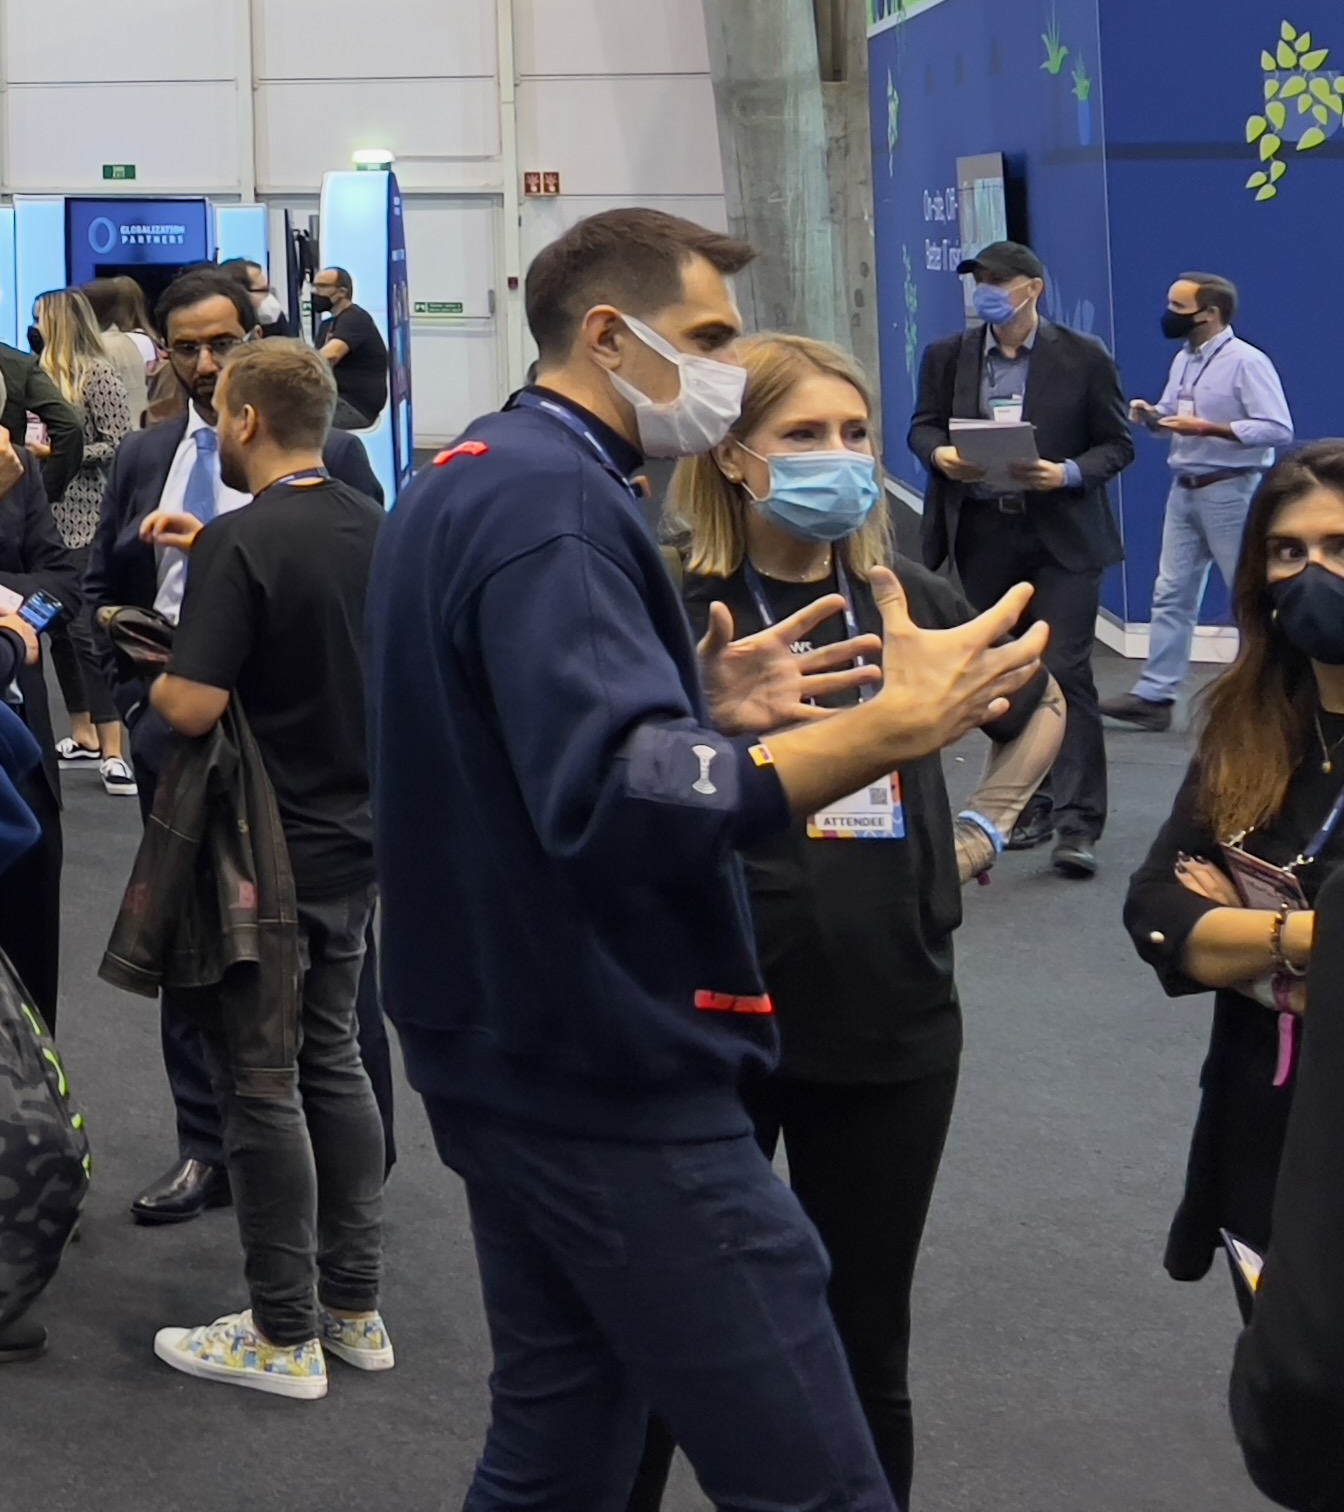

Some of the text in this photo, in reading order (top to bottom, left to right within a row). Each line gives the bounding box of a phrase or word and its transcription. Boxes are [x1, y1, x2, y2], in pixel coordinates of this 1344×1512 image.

[120, 225, 185, 235] GLOBALIZATION
[121, 234, 184, 245] PARTNERS
[823, 815, 885, 828] ATTENDEE
